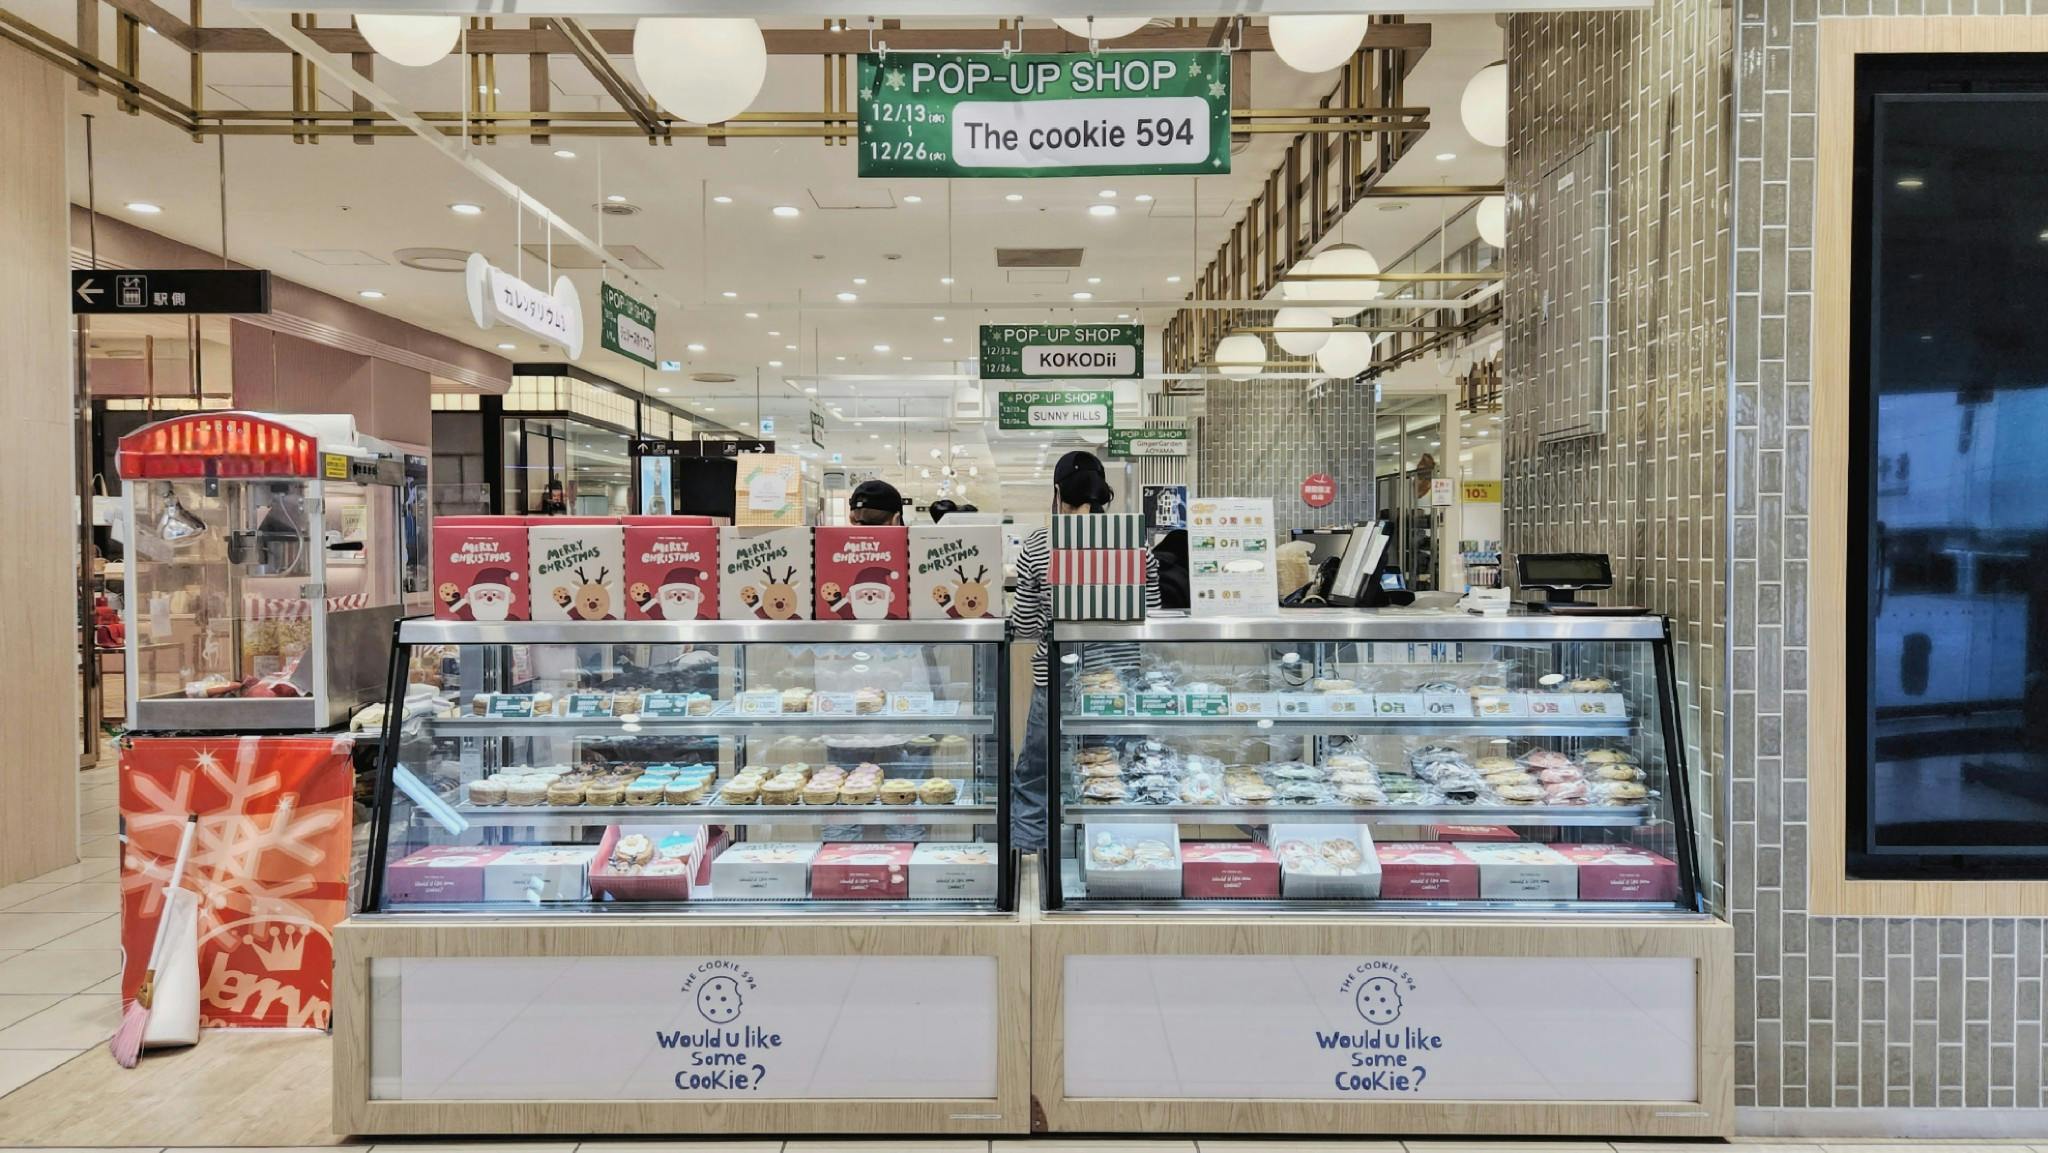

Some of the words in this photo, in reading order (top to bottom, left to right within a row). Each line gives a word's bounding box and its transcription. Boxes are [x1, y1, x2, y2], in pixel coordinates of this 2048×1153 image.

[911, 62, 1061, 95] POP-UP
[1071, 60, 1177, 92] SHOP
[964, 122, 1018, 150] The
[1029, 120, 1125, 149] cookie
[1136, 117, 1194, 147] 594
[1004, 328, 1071, 343] POP-UP
[1073, 328, 1121, 343] SHOP
[1040, 352, 1116, 367] KOKODii
[1065, 393, 1097, 403] SHOP
[1033, 411, 1069, 421] SUNNY
[1073, 411, 1101, 421] HILLS
[681, 973, 697, 993] THE
[698, 960, 740, 973] COOKIE
[741, 971, 757, 990] 594
[1340, 973, 1355, 993] THE
[1356, 961, 1399, 973] COOKIE
[1401, 972, 1416, 991] 594
[656, 1028, 721, 1048] Would
[745, 1025, 782, 1049] like
[1316, 1029, 1380, 1049] Would
[1405, 1026, 1442, 1051] like
